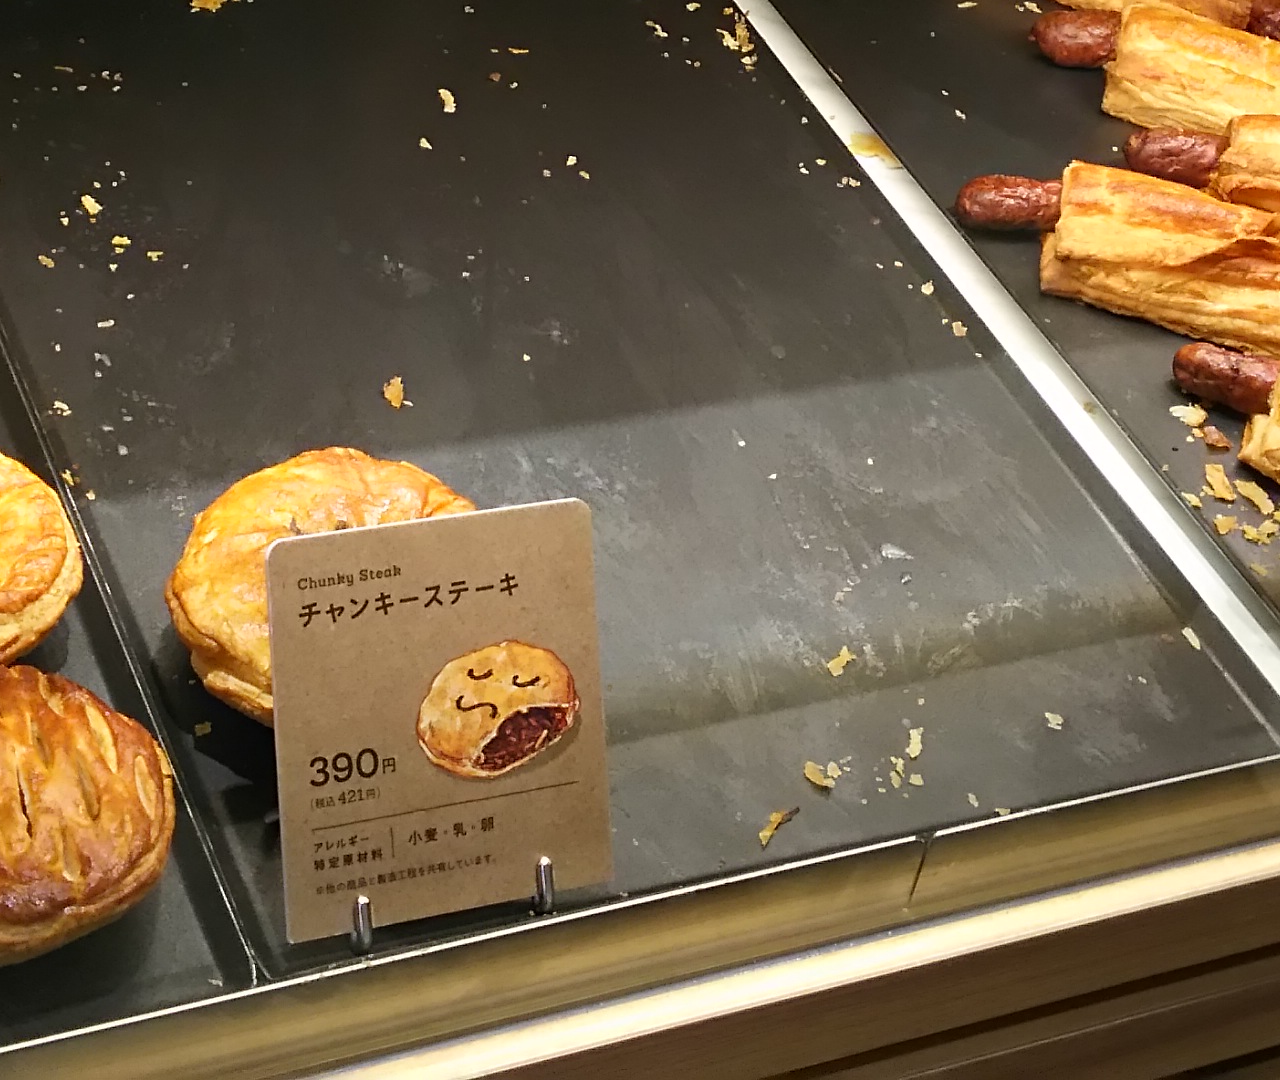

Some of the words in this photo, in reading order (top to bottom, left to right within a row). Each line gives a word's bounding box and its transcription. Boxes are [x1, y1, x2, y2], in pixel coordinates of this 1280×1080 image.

[297, 571, 354, 591] Chunky
[359, 564, 402, 582] Steak
[298, 572, 520, 628] チャンキーステーキ
[309, 746, 397, 788] 390円
[314, 834, 370, 854] アレルギー
[408, 816, 495, 846] 小麦・乳・卵
[313, 848, 383, 871] 特定原材料
